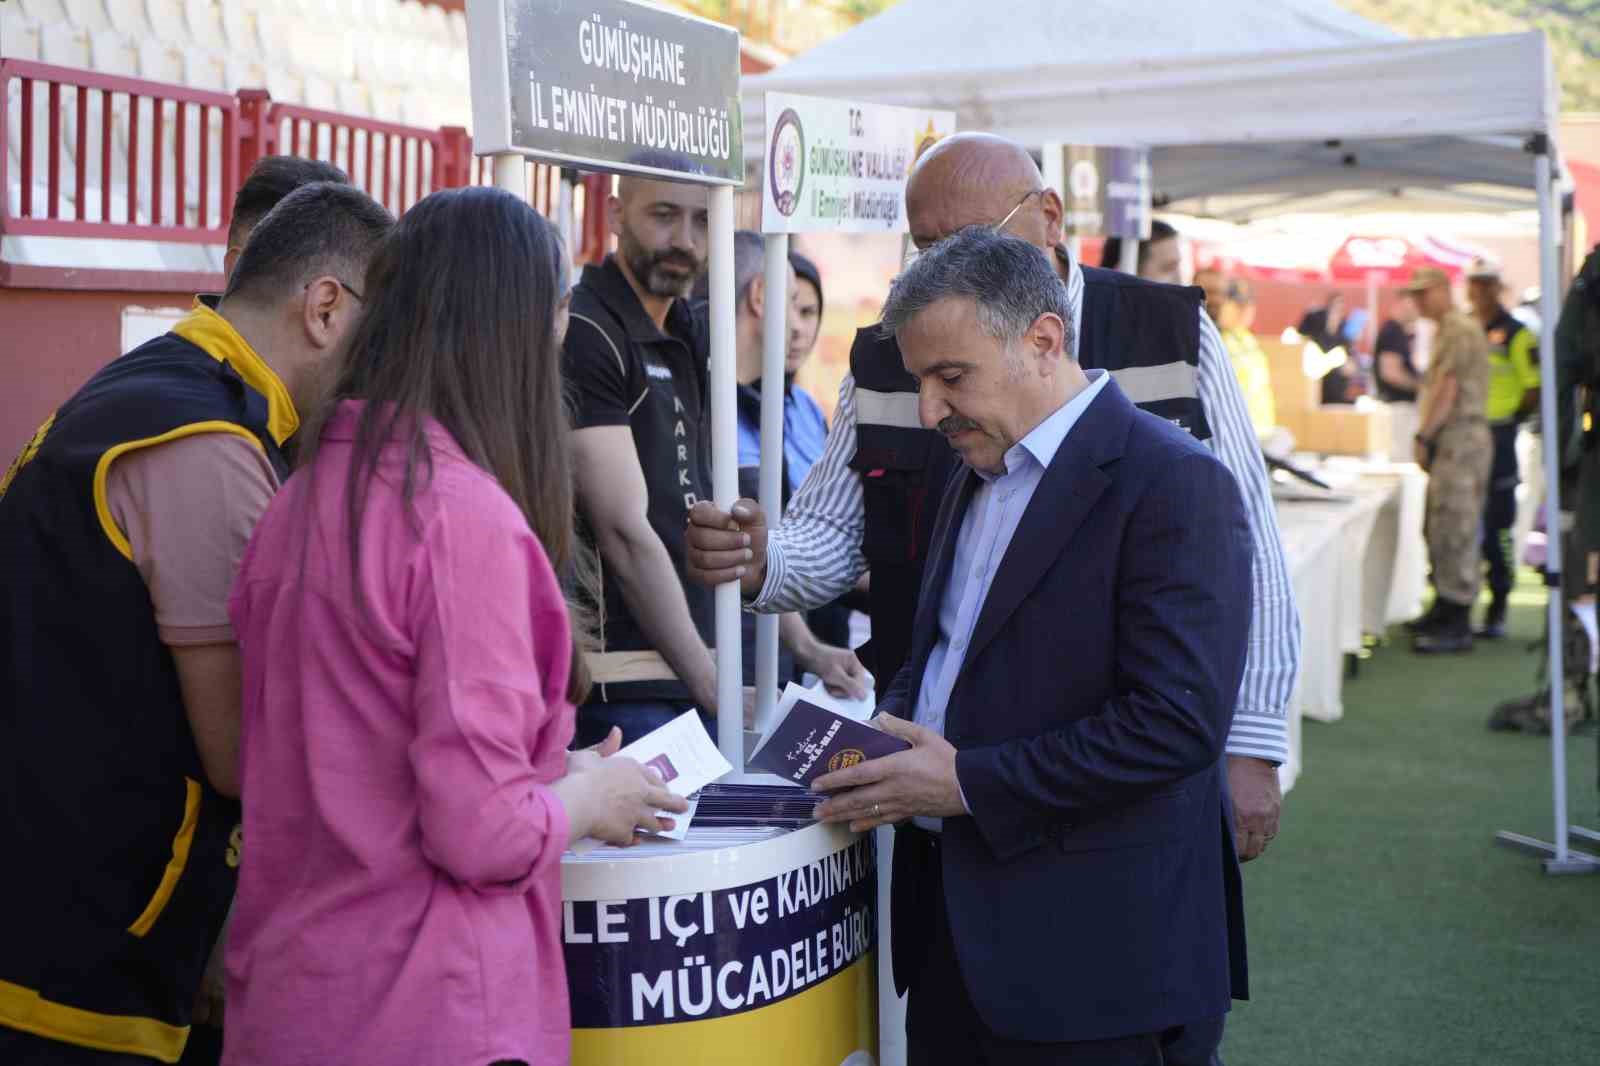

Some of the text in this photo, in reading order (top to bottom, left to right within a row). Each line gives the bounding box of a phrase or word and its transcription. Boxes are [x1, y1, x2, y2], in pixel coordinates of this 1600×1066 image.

[578, 13, 686, 86] GÜMÜŞHANE
[529, 70, 730, 160] İL EMNİYET MÜDÜRLÜĞÜ
[728, 886, 769, 929] ve
[777, 847, 852, 918] KADINA
[631, 929, 829, 1021] MÜCADELE
